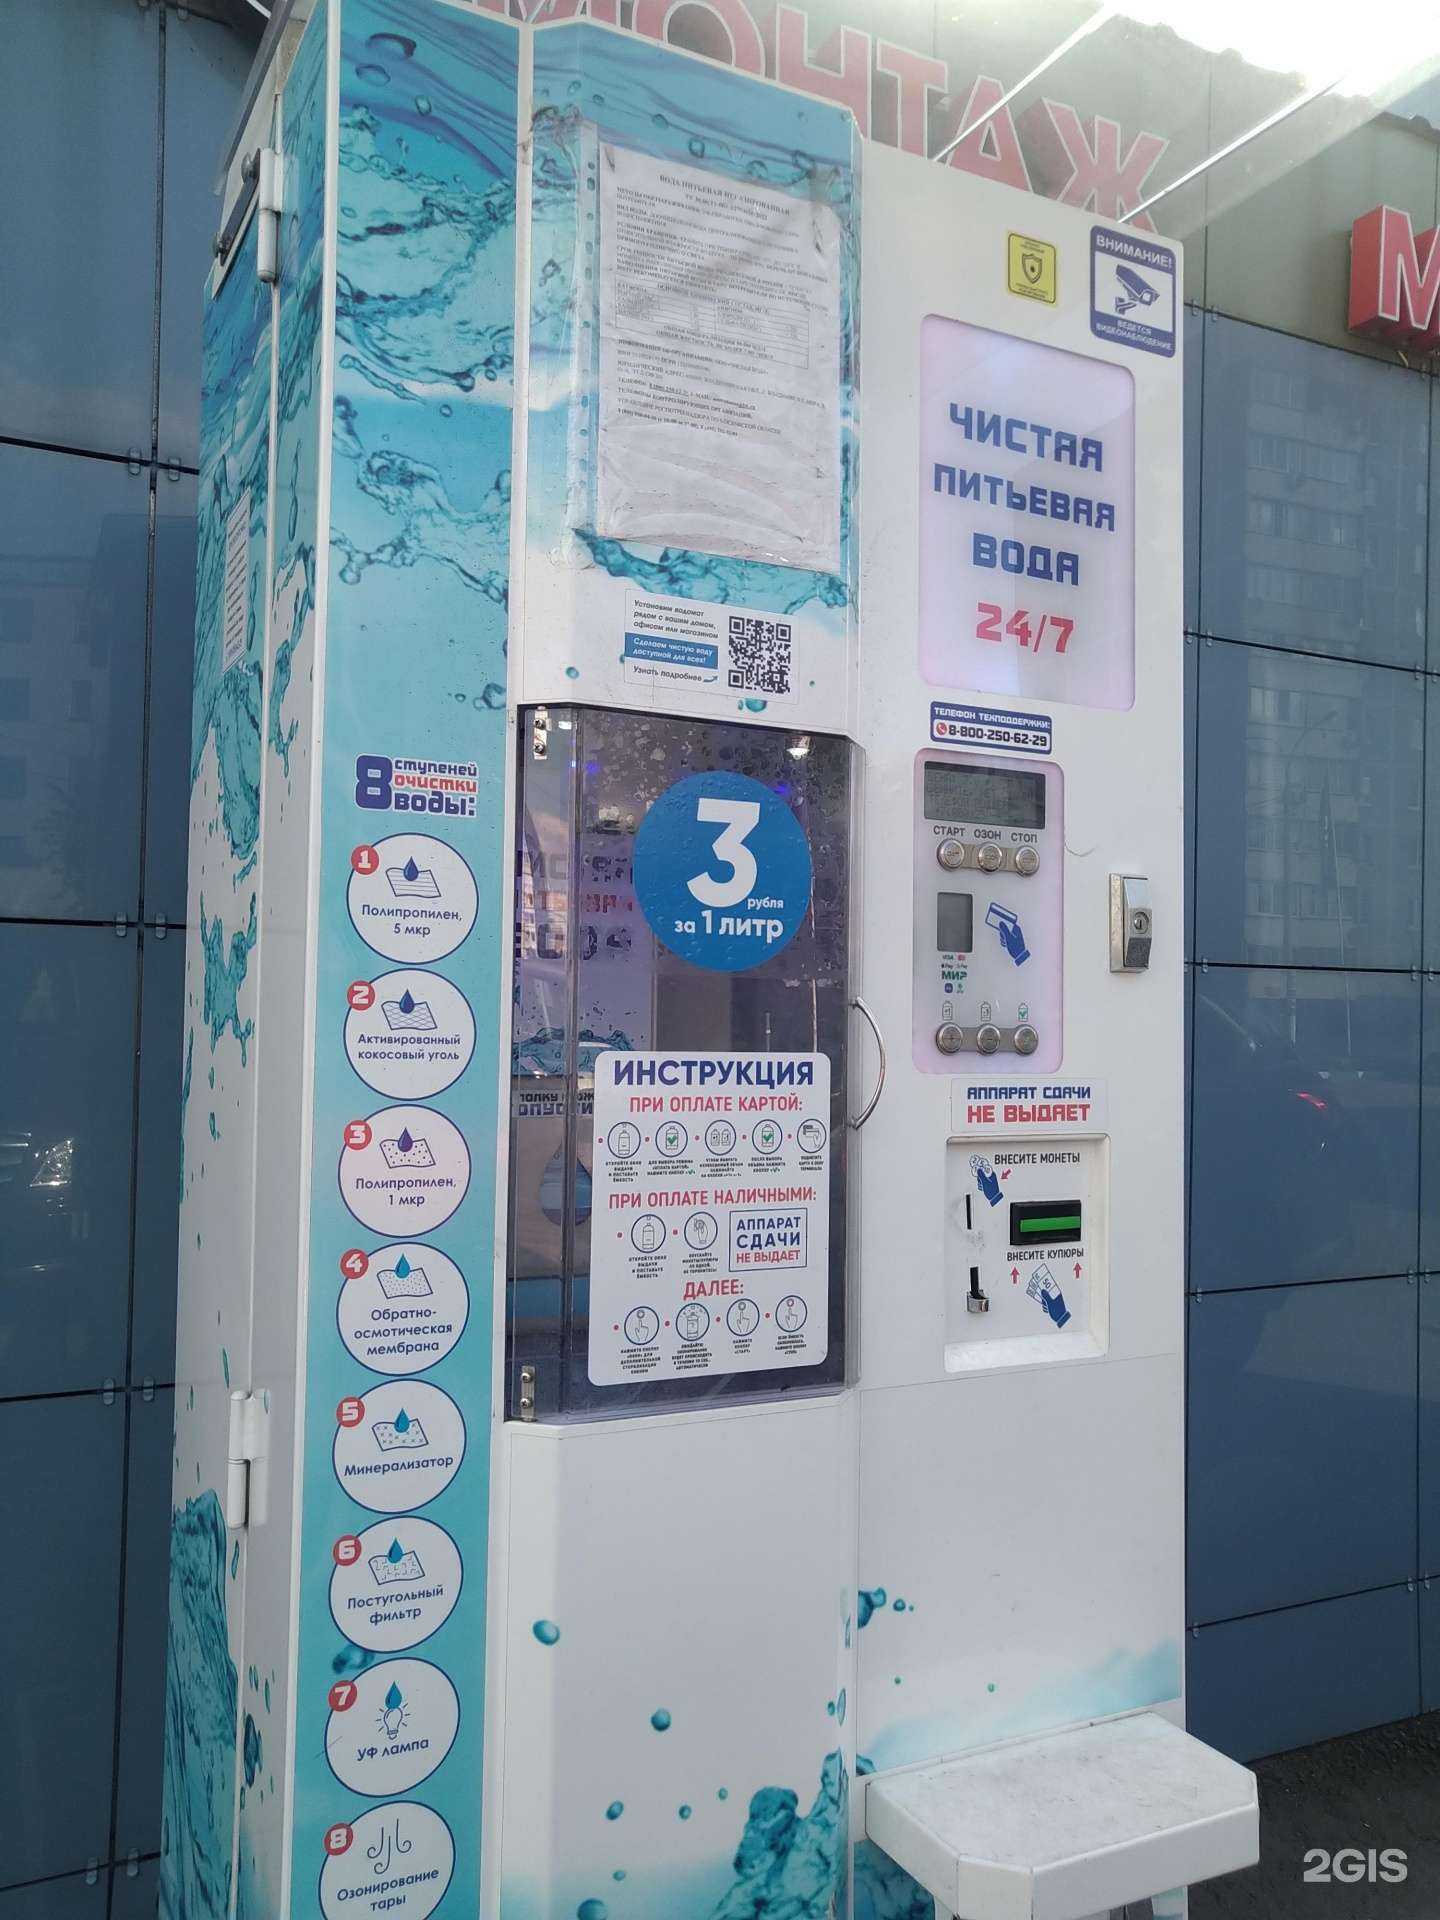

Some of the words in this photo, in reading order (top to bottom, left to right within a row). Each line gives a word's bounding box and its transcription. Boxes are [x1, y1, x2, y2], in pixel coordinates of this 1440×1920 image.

[1096, 235, 1172, 269] ВНИМАНИЕ!
[949, 402, 1103, 472] ЧИСТАЯ
[934, 463, 1115, 532] ПИТЬЕВАЯ
[972, 532, 1079, 586] ВОДА
[634, 611, 656, 619] рядом
[976, 602, 1074, 654] 24/7
[633, 649, 671, 658] доступной
[634, 638, 666, 648] Сделаем
[696, 648, 712, 657] воду
[634, 666, 658, 675] Узнать
[661, 670, 702, 682] подробнее
[934, 707, 976, 719] ТЕЛЕФОН
[979, 713, 1050, 728] ТЕХПОДДЕРЖКИ:
[949, 725, 1047, 747] 8-800-250-62-29
[356, 755, 392, 810] 8
[395, 760, 477, 776] ступеней
[394, 774, 476, 792] очистки
[394, 791, 475, 816] воды:
[933, 825, 965, 836] СТАРТ
[974, 829, 1001, 840] ОЗОН
[1011, 833, 1038, 843] СТОП
[358, 850, 371, 868] 1
[687, 797, 760, 908] 3
[747, 896, 784, 910] рубля
[361, 904, 463, 922] Полипропилен,
[394, 923, 401, 935] 5
[404, 926, 431, 937] мкр
[674, 920, 695, 933] за
[701, 910, 712, 934] 1
[719, 917, 784, 943] литр
[942, 971, 967, 980] МИР
[352, 986, 369, 1004] 2
[358, 1033, 461, 1047] Активированный
[358, 1048, 424, 1061] кокосовый
[428, 1050, 459, 1062] уголь
[614, 1060, 813, 1089] ИНСТРУКЦИЯ
[630, 1097, 663, 1112] ПРИ
[670, 1096, 732, 1112] ОПЛАТЕ
[738, 1092, 803, 1111] КАРТОЙ:
[968, 1086, 1037, 1100] АППАРАТ
[1043, 1086, 1090, 1099] СДАЧИ
[967, 1106, 995, 1123] НЕ
[1004, 1104, 1090, 1122] ВЫДАЕТ
[349, 1125, 366, 1145] 3
[994, 1154, 1037, 1165] ВНЕСИТЕ
[1040, 1152, 1080, 1164] МОНЕТЫ
[356, 1177, 457, 1191] Полипропилен,
[388, 1194, 395, 1206] 1
[399, 1195, 425, 1209] мкр
[609, 1194, 641, 1209] ПРИ
[647, 1190, 708, 1207] ОПЛАТЕ
[714, 1187, 816, 1205] НАЛИЧНЫМИ:
[736, 1216, 801, 1231] АППАРАТ
[736, 1232, 801, 1250] СДАЧИ
[346, 1255, 363, 1273] 4
[736, 1253, 750, 1263] НЕ
[754, 1250, 800, 1262] ВЫДАЕТ
[1007, 1251, 1044, 1262] ВНЕСИТЕ
[1048, 1248, 1084, 1260] КУПЮРЫ
[683, 1279, 744, 1300] ДАЛЕЕ:
[371, 1309, 437, 1323] Обратно-
[354, 1325, 453, 1339] осмотическая
[367, 1341, 439, 1356] мембрана
[342, 1403, 359, 1422] 5
[344, 1455, 454, 1478] Минерализатор
[338, 1542, 356, 1559] 6
[347, 1585, 444, 1610] Постугольный
[369, 1607, 422, 1626] фильтр
[336, 1686, 351, 1706] 7
[382, 1739, 429, 1757] лампа
[330, 1829, 349, 1849] 8
[337, 1868, 440, 1902] Озонирование
[370, 1894, 406, 1913] тары
